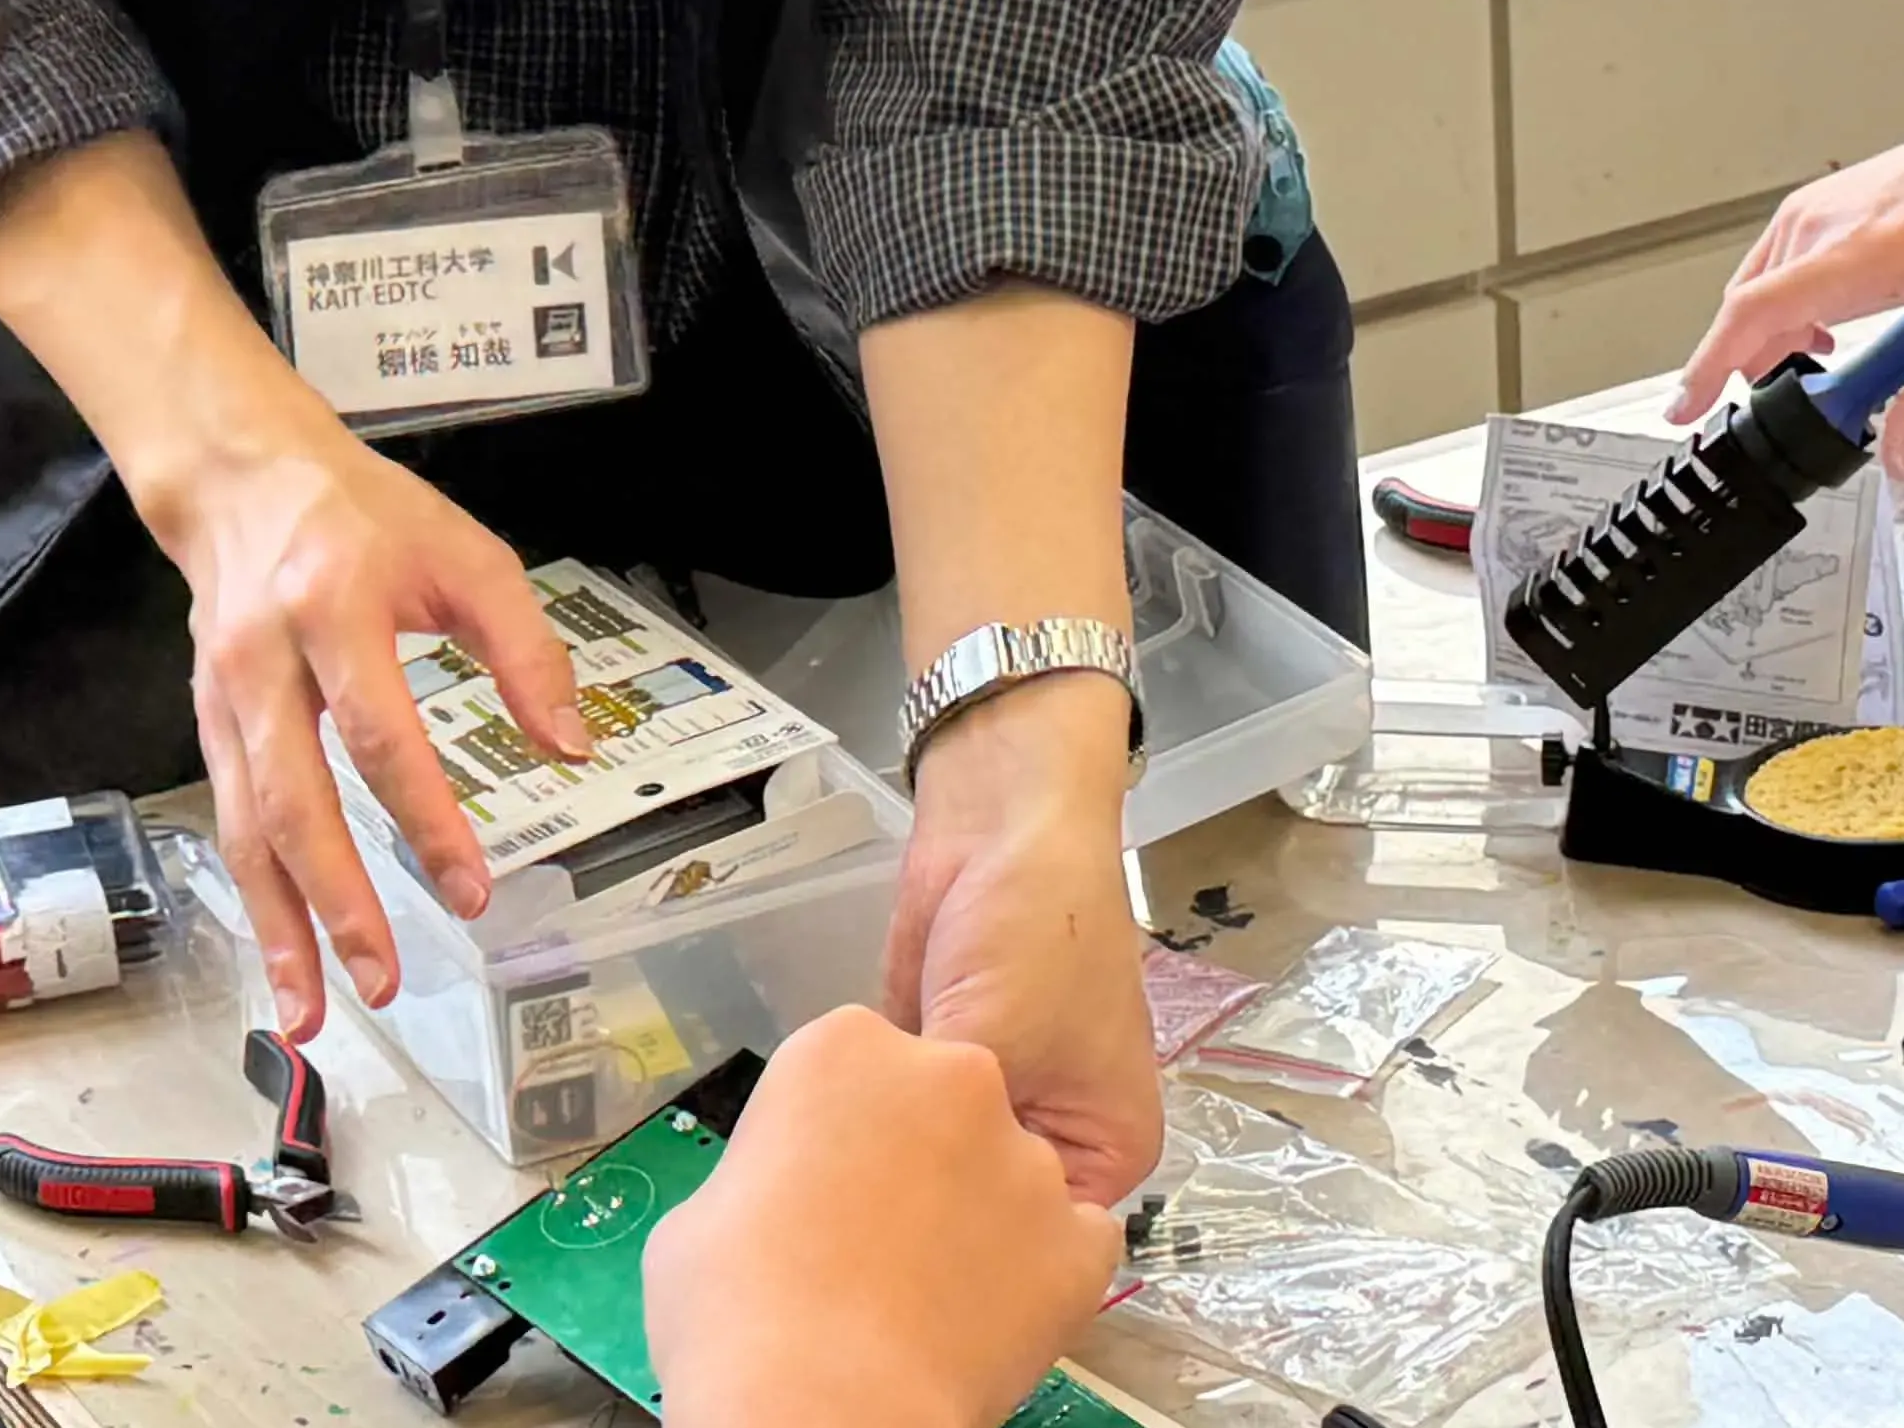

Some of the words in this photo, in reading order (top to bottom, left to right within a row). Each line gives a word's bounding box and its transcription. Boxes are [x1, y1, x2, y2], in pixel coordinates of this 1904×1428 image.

[307, 247, 494, 287] 神奈川工科大学
[308, 286, 364, 311] KAIT
[373, 278, 438, 305] EDTC
